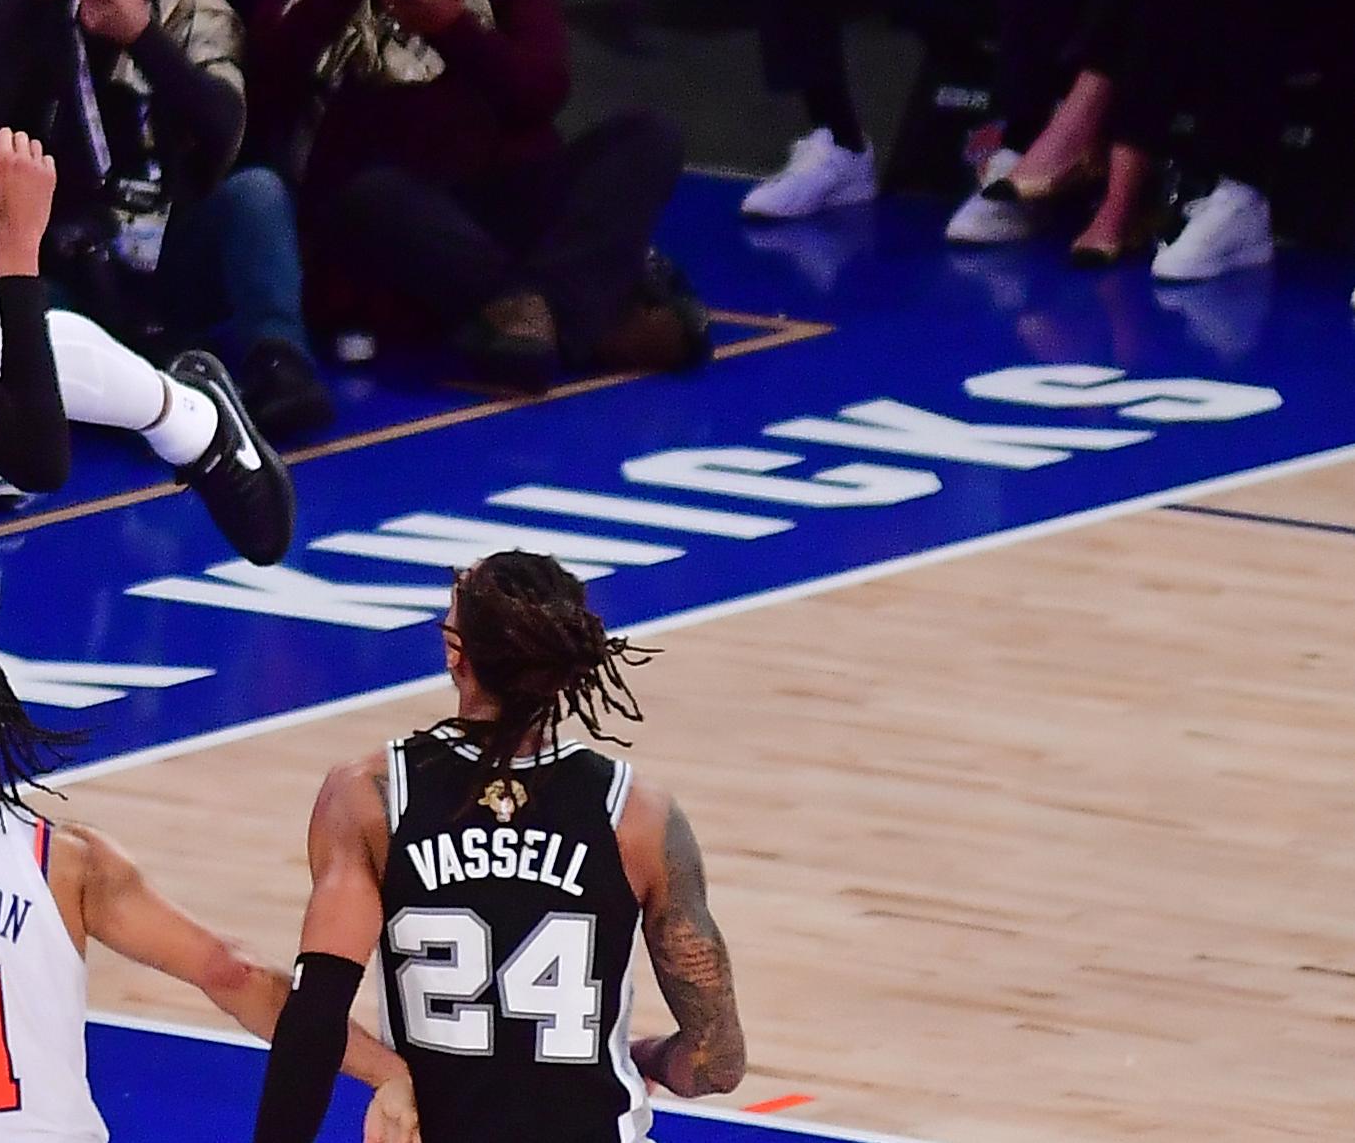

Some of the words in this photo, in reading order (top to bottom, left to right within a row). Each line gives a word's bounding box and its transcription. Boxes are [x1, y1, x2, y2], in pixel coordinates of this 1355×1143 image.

[124, 362, 1285, 631] KNICKS
[406, 827, 589, 897] VASSELL
[387, 906, 603, 1065] 24
